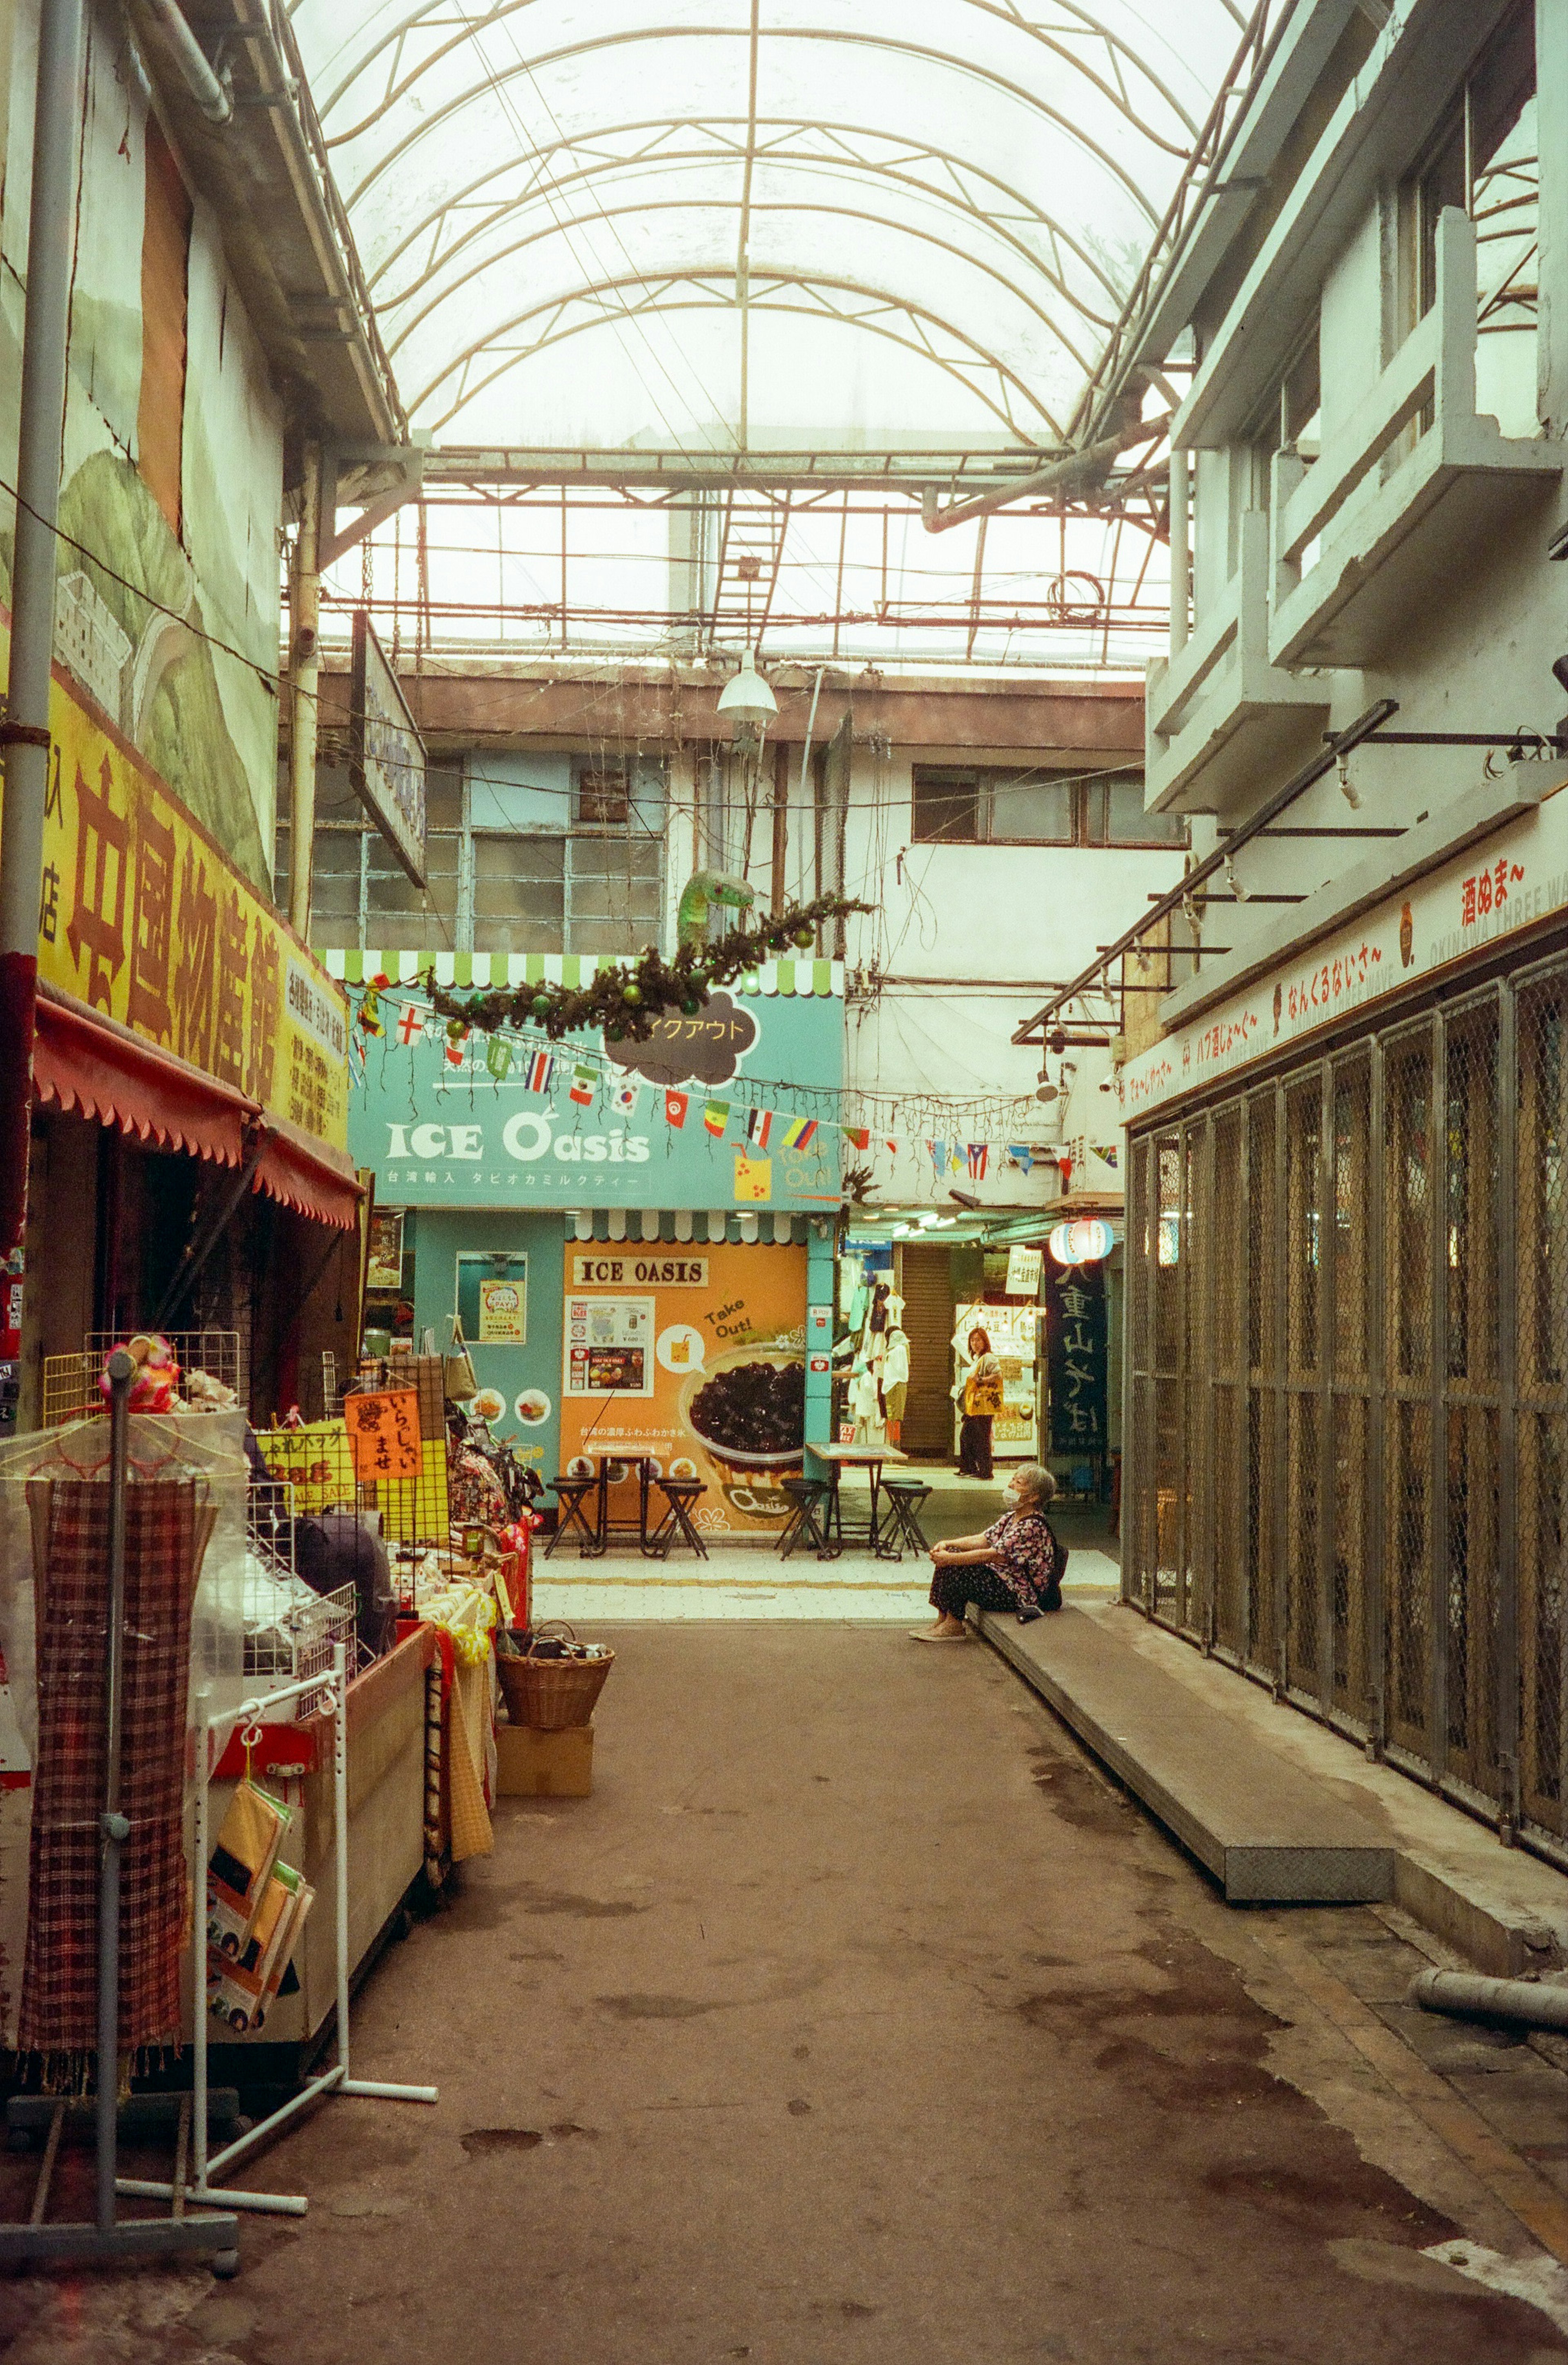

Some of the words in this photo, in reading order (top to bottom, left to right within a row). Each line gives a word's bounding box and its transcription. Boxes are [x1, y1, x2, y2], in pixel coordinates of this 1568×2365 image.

[632, 1019, 743, 1040] イクアウト
[385, 1123, 483, 1160] ICE
[502, 1105, 650, 1162] Oasis
[387, 1171, 455, 1184] 台湾輸入
[472, 1172, 639, 1186] タピオカミルクティー
[581, 1262, 623, 1281] ICE
[635, 1262, 702, 1282] OASIS
[704, 1300, 744, 1325] Take
[715, 1317, 752, 1338] Out!
[390, 1396, 418, 1470] いらっしゃい
[374, 1435, 391, 1470] ませ
